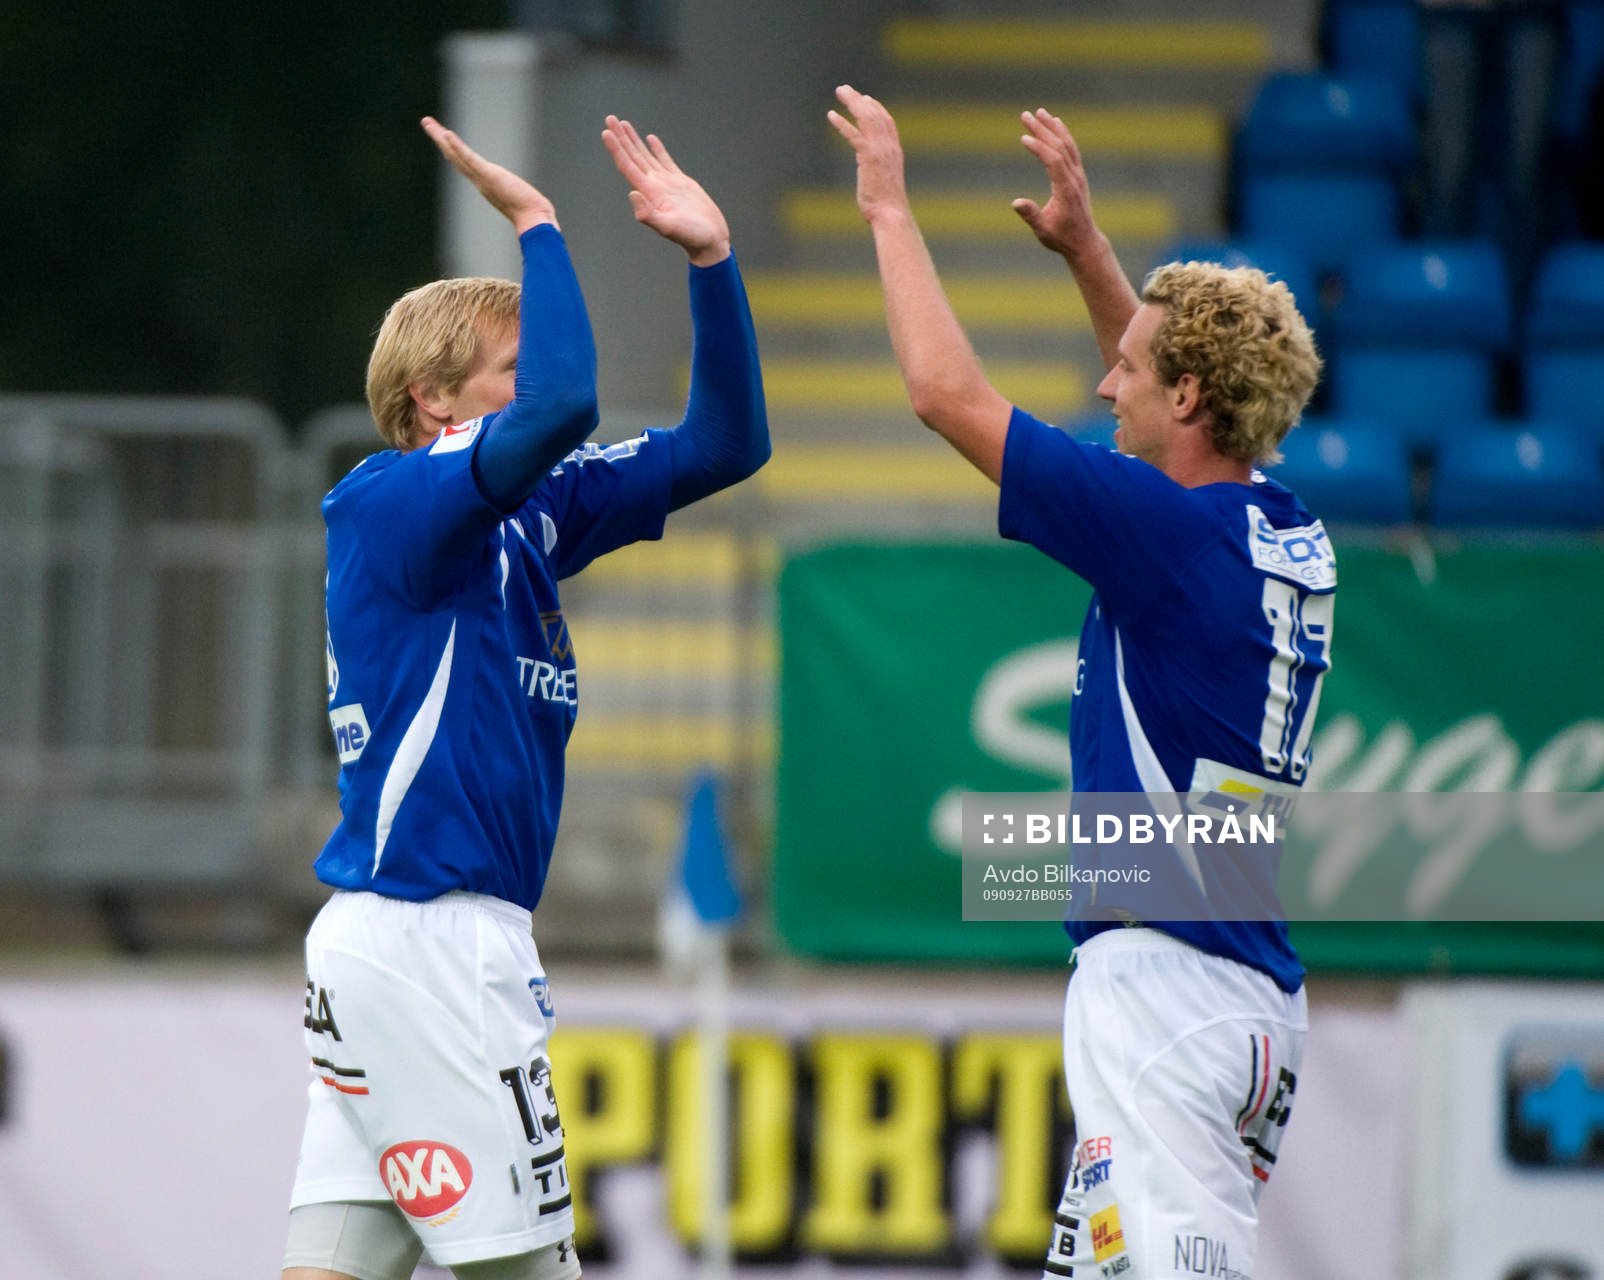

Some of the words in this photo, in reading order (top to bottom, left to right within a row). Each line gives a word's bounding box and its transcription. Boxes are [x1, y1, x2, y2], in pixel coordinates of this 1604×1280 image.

[499, 1057, 564, 1146] 13
[386, 1147, 466, 1201] AXA
[1174, 1234, 1228, 1280] NOVA
